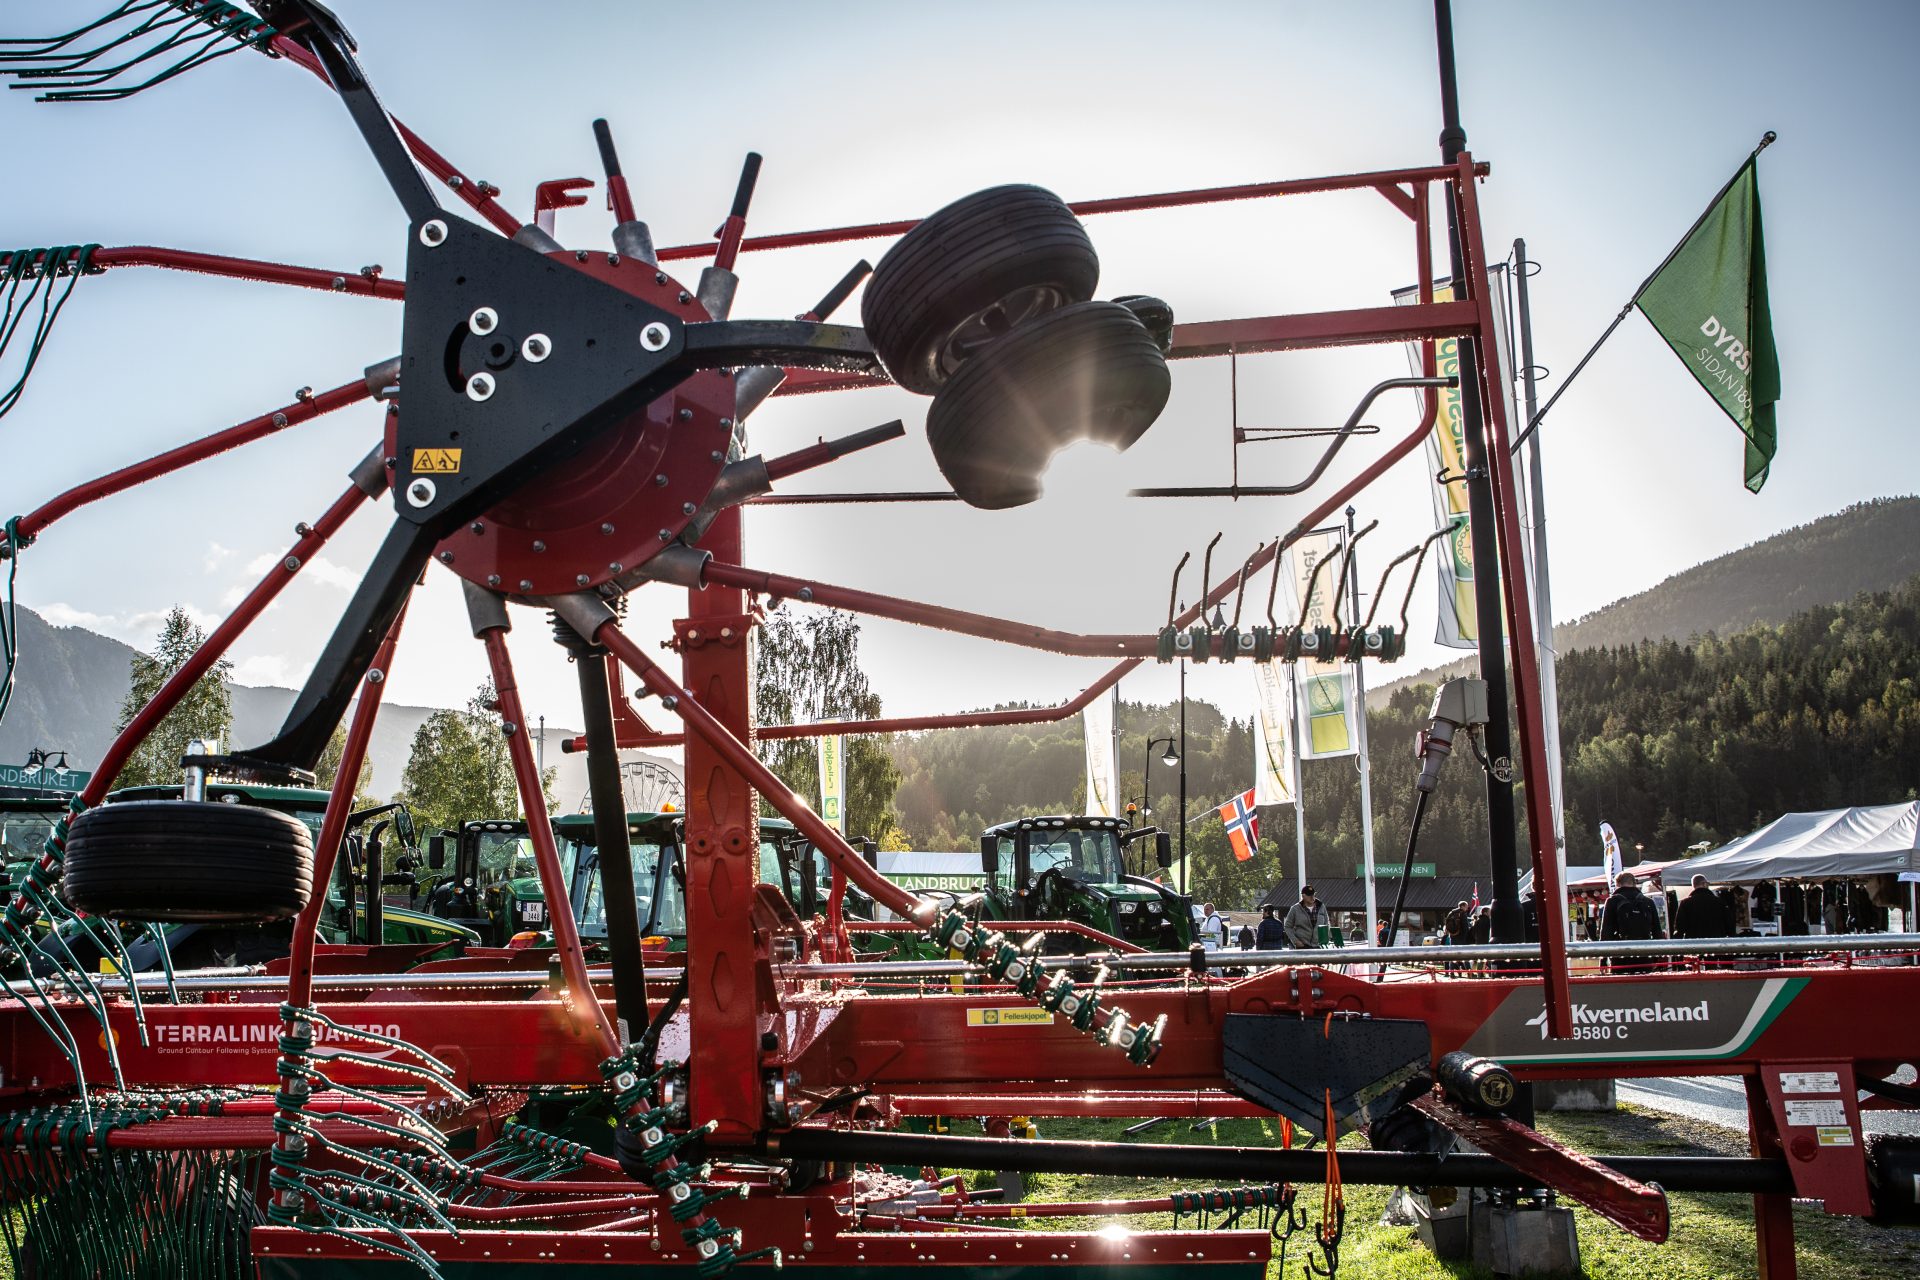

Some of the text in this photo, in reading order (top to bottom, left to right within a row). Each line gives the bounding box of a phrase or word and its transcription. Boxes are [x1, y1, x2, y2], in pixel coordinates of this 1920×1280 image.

[1700, 315, 1751, 376] DYRS
[1697, 347, 1739, 391] SIDAN
[1571, 1000, 1709, 1024] Kverneland
[155, 1024, 283, 1042] TERRALINK
[1572, 1025, 1629, 1041] 9580 C
[216, 1047, 250, 1056] Following
[251, 1047, 279, 1056] System
